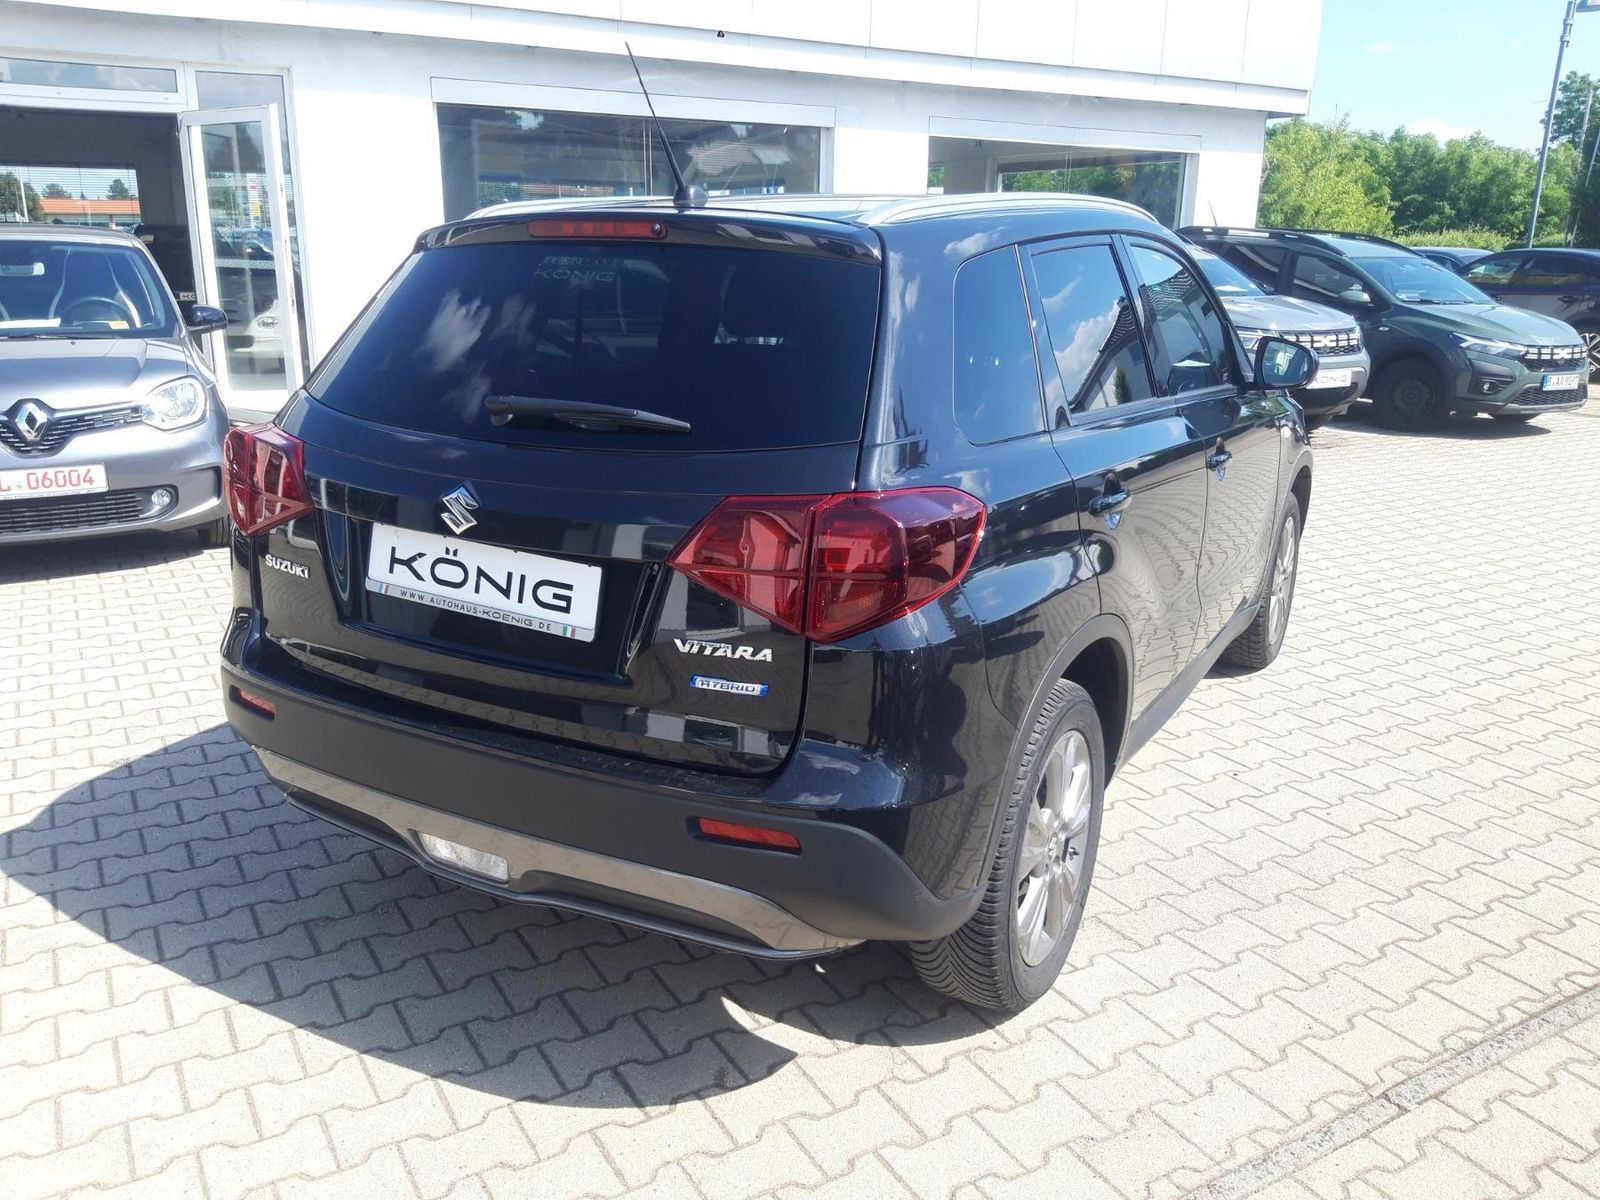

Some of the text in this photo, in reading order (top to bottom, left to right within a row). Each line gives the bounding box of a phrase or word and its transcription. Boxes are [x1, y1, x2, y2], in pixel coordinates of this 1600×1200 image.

[26, 468, 95, 490] 06004
[265, 553, 310, 579] SUZUKI
[388, 546, 574, 614] KÖNIG
[399, 589, 552, 632] WWW.AUTOHAUS-KOENIG.DE
[673, 638, 773, 662] VITARA
[698, 679, 757, 694] HYBRID
